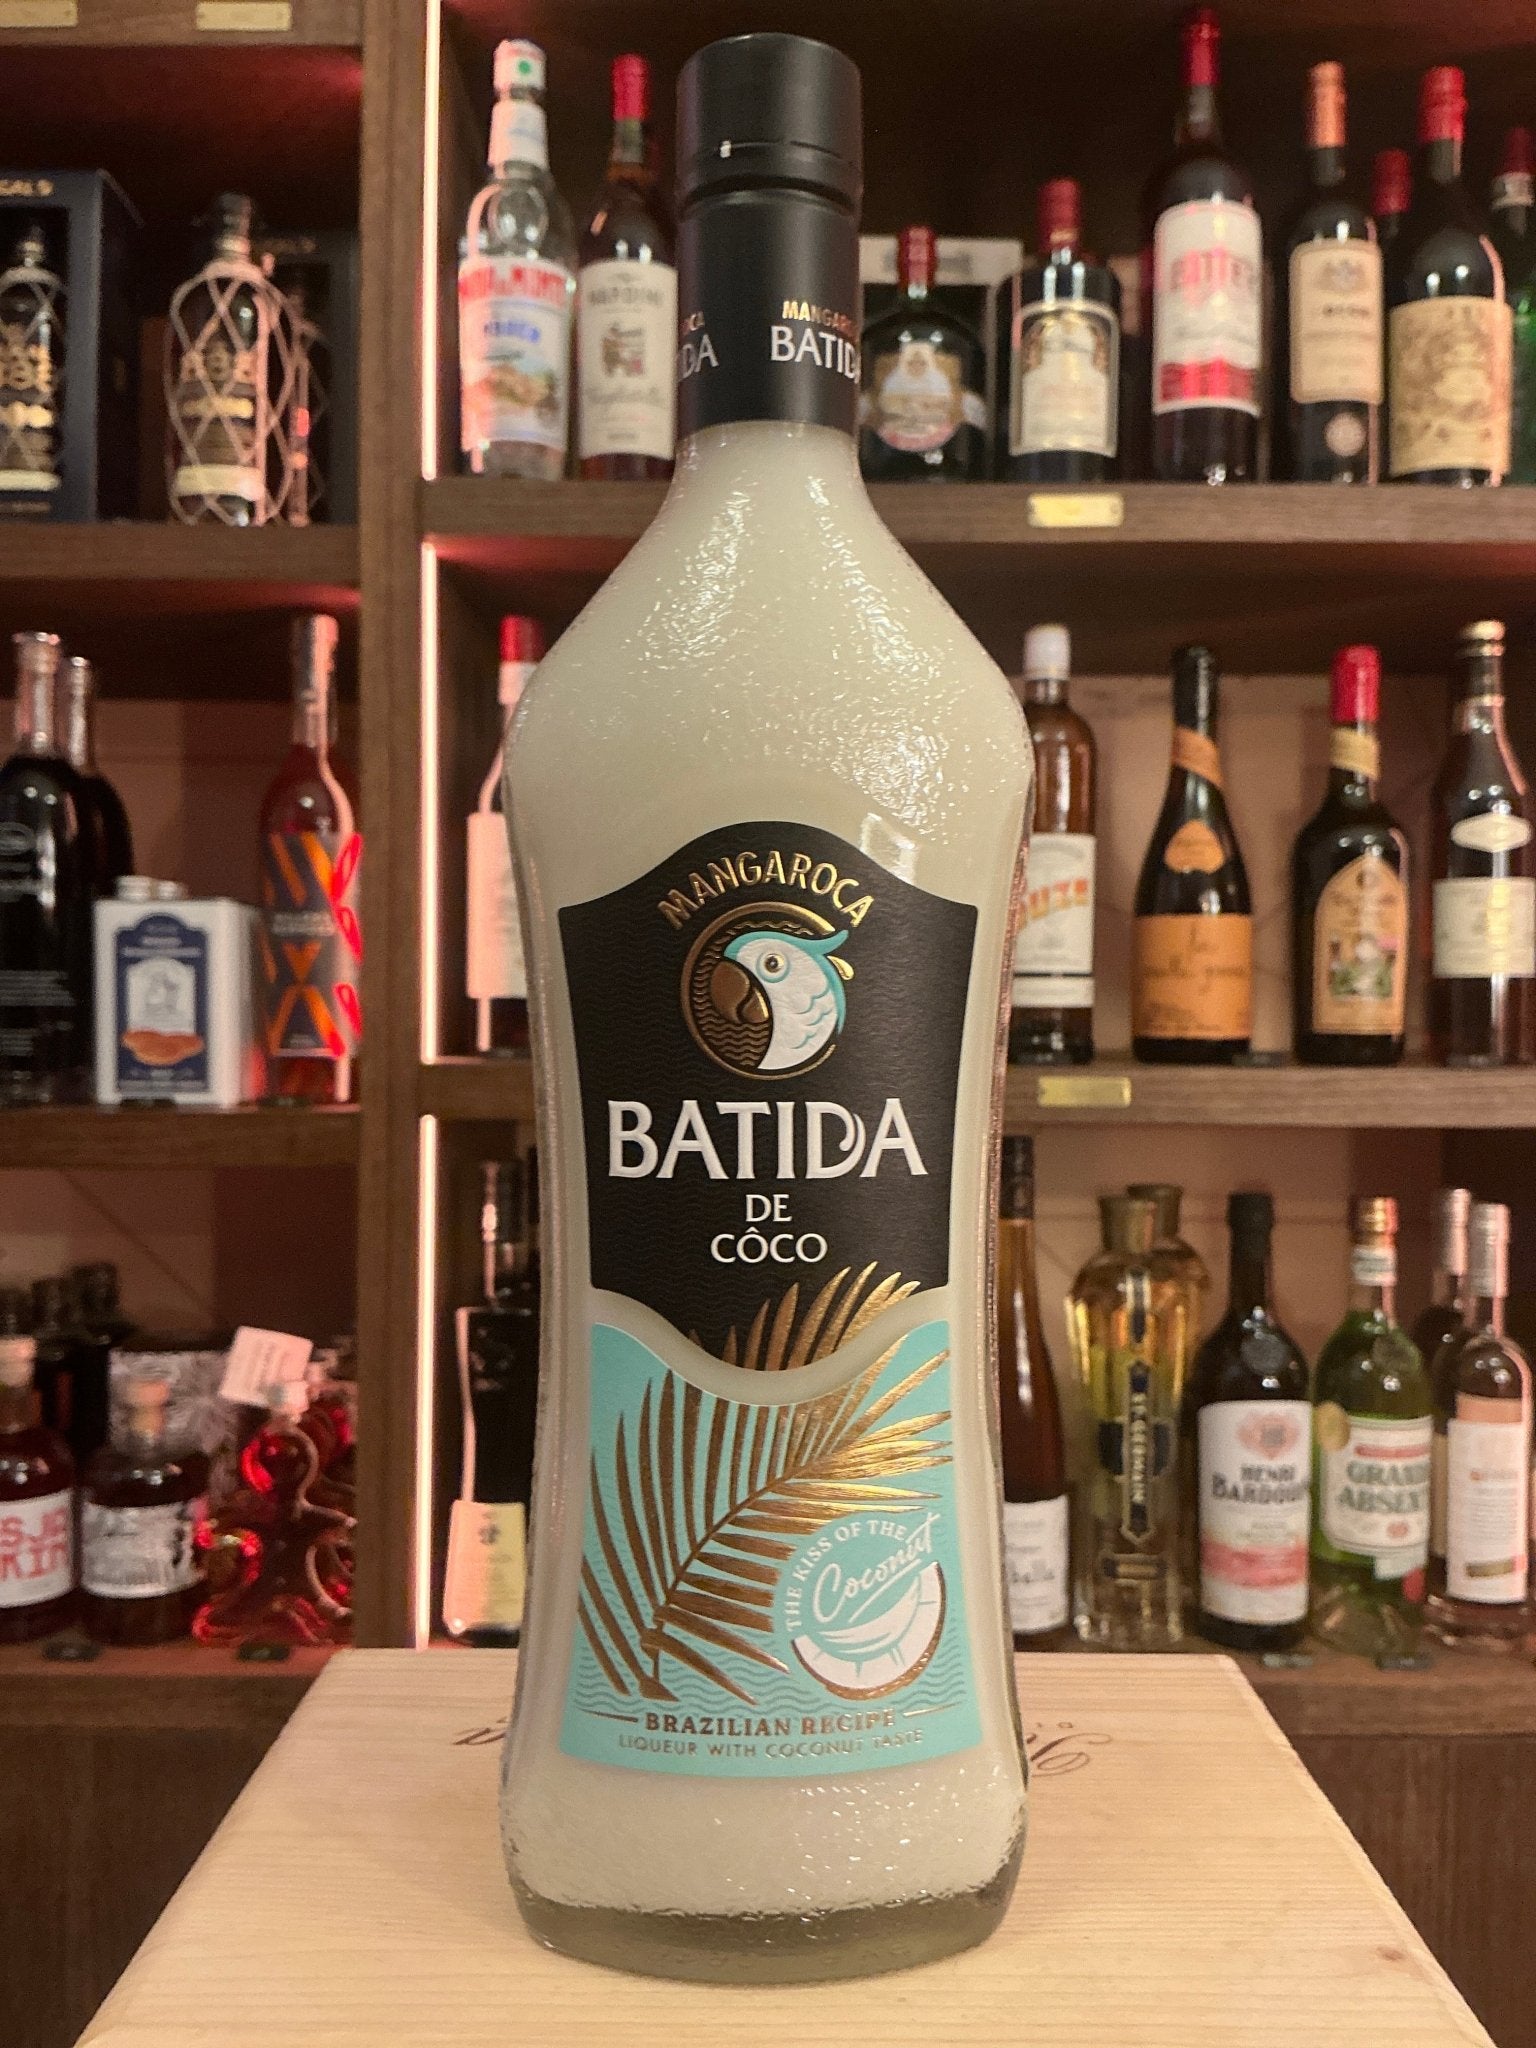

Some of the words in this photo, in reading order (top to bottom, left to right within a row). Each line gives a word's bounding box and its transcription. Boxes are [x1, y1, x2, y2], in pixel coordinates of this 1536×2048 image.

[657, 850, 875, 931] MANGAROCA
[608, 1098, 929, 1180] BATIDA
[745, 1194, 793, 1222] DE
[710, 1226, 829, 1264] CÔCO
[834, 1521, 862, 1542] OF
[866, 1519, 908, 1541] THE
[792, 1537, 833, 1583] KISS
[812, 1512, 941, 1623] Coconut
[784, 1587, 803, 1632] THE
[645, 1712, 792, 1737] BRAZILIAN
[801, 1708, 897, 1735] RECIPE
[619, 1734, 698, 1757] LIQUEUR
[707, 1743, 757, 1758] WITH
[765, 1738, 864, 1759] COCONUT
[872, 1728, 924, 1750] TASTE
